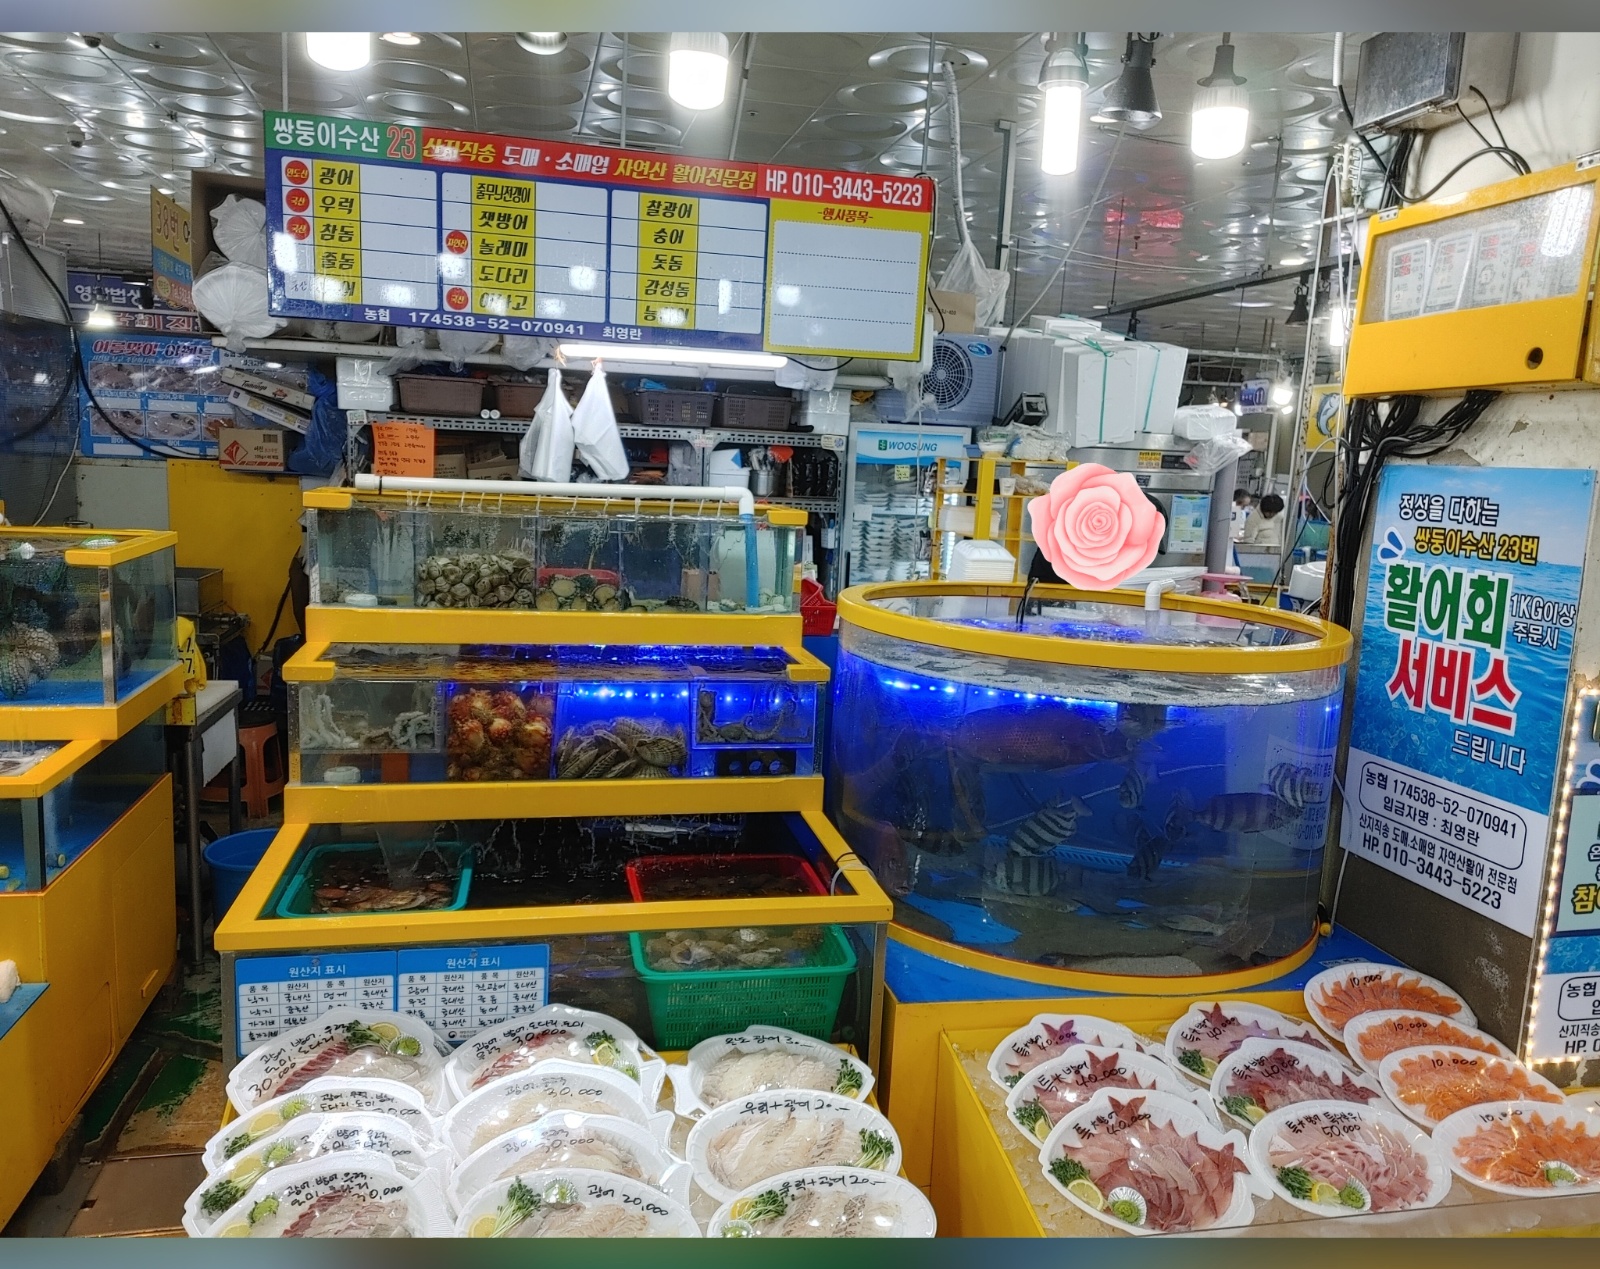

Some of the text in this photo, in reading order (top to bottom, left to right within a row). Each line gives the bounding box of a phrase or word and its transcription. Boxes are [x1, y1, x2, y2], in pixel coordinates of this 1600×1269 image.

[273, 118, 416, 160] 쌍둥이수산 23
[320, 167, 354, 186] 광어
[502, 146, 540, 166] 도매
[555, 153, 610, 174] 소매업
[613, 158, 666, 181] 자연산
[672, 163, 757, 190] 활어전문점
[766, 169, 788, 194] HP.
[792, 172, 922, 207] 010-3443-5223
[291, 196, 354, 214] 국산 우럭
[646, 200, 693, 219] 찰광어
[478, 211, 528, 230] 잿방어
[292, 224, 354, 242] 국산 참돔
[653, 228, 684, 245] 숭어
[479, 238, 528, 258] 놀래미
[322, 252, 354, 270] 줄돔
[653, 254, 684, 272] 돗돔
[479, 266, 528, 284] 도다리
[644, 279, 690, 298] 감성돔
[450, 295, 464, 303] 국산
[364, 308, 642, 342] 농협 174538-52-070941 최영란
[888, 441, 938, 452] WOOSUNG
[1400, 493, 1500, 526] 정성을 다하는
[1414, 526, 1540, 565] 쌍둥이수산 23번
[1386, 562, 1510, 650] 활어회
[1511, 593, 1576, 627] 1KG이상
[1513, 622, 1559, 650] 주문시
[1389, 638, 1520, 732] 서비스
[1452, 730, 1526, 775] 드립니다
[1365, 768, 1517, 840] 농협 174538-52-070941
[1384, 797, 1480, 847] 입금자명 최영란
[1360, 813, 1390, 838] 산지직송
[1438, 846, 1486, 880] 자연산활어
[1488, 866, 1518, 894] 전문점
[1362, 834, 1502, 909] HP. 010-3443-5223
[288, 964, 346, 978] 원산지 표시
[446, 957, 500, 968] 원산지 표시
[287, 982, 309, 990] 원산지
[364, 978, 384, 986] 원산지
[444, 974, 464, 982] 원산지
[516, 970, 536, 978] 원산지
[408, 986, 429, 994] 광어
[442, 985, 464, 993] 국내산
[514, 982, 537, 990] 국내산
[1566, 982, 1596, 998] 농협
[284, 993, 311, 1002] 국내산
[441, 996, 464, 1005] 국내산
[512, 993, 538, 1002] 국내산
[441, 1008, 466, 1018] 국내산
[442, 1018, 466, 1028] 국내산
[753, 1035, 780, 1044] 광어
[1564, 1039, 1587, 1054] HP.
[588, 1184, 614, 1198] 광어
